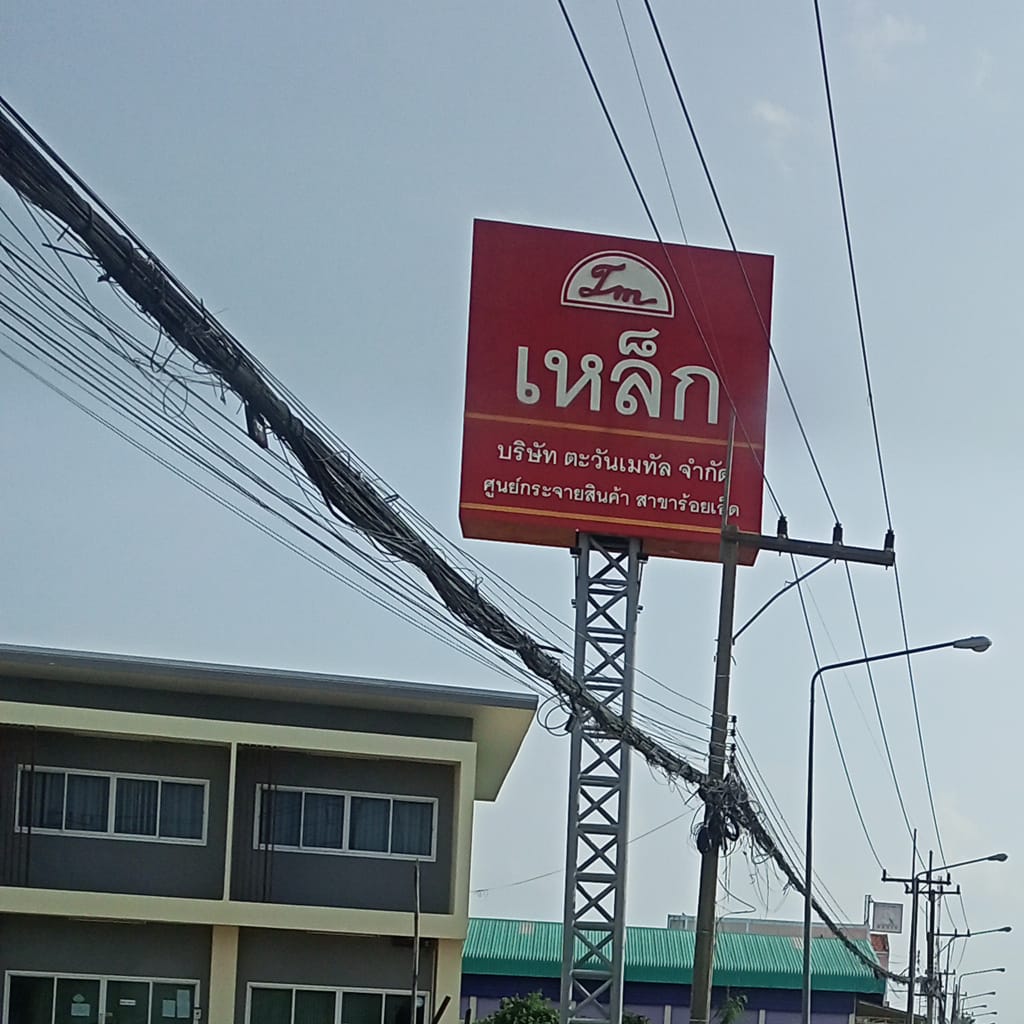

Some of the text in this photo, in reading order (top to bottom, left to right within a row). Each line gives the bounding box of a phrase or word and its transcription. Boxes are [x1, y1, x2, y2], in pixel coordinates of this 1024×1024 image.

[515, 327, 720, 425] เหล็ก
[497, 439, 557, 465] บริษัท
[564, 447, 671, 477] ตะวันเมทัล
[483, 476, 630, 506] ศูนย์กระจายสินค้า
